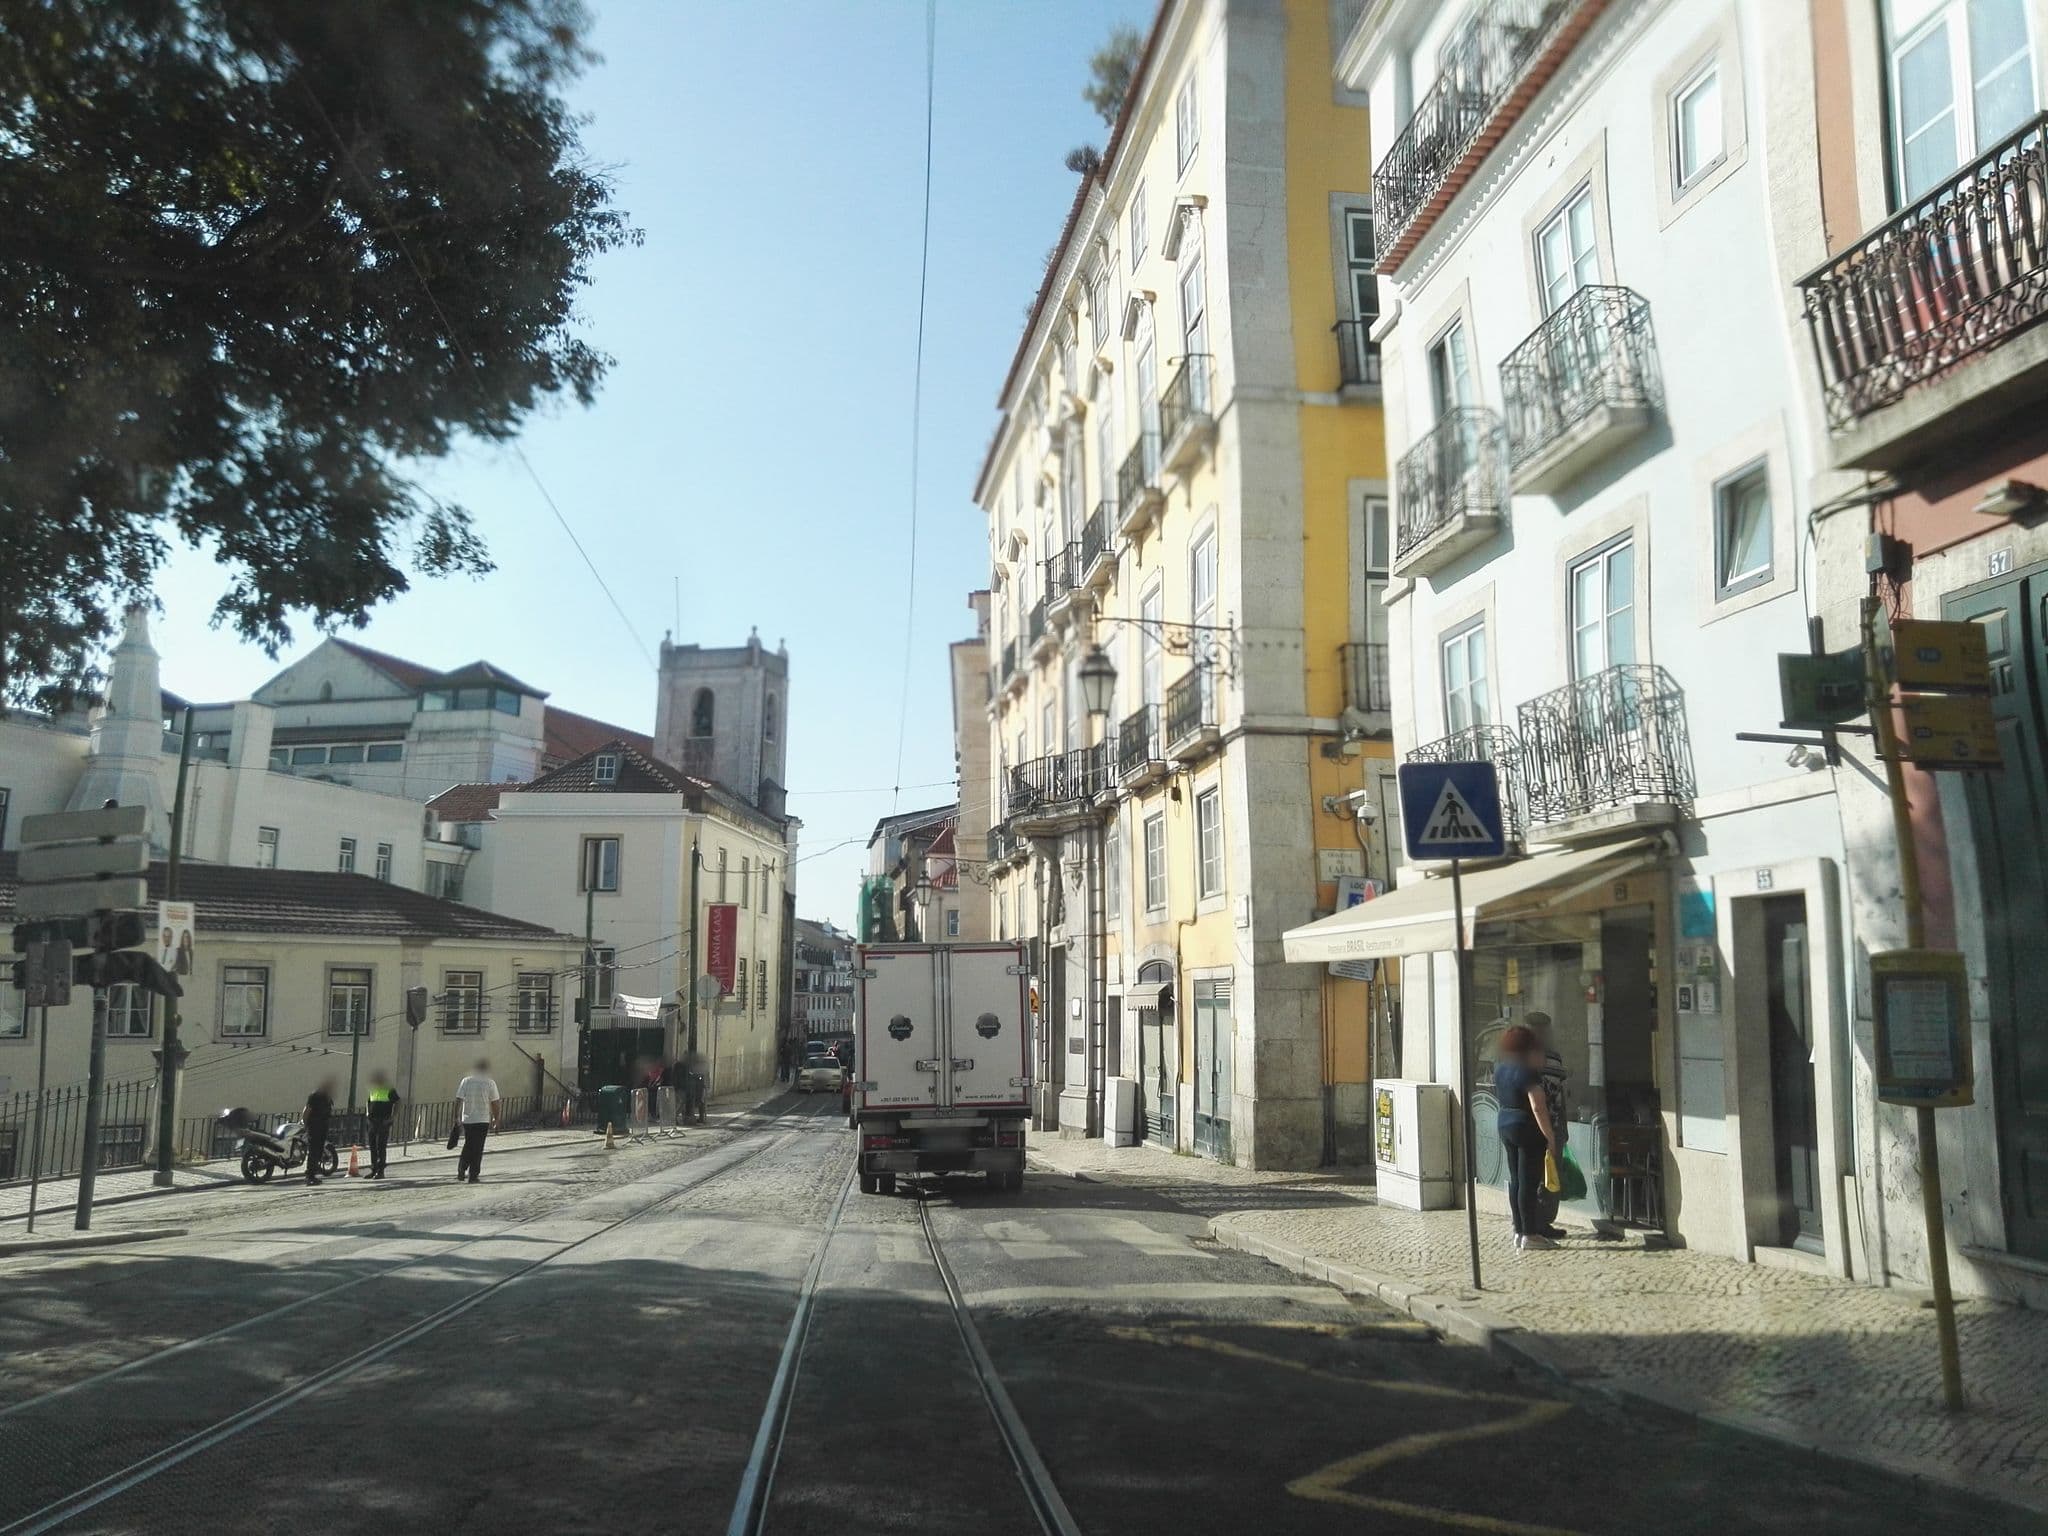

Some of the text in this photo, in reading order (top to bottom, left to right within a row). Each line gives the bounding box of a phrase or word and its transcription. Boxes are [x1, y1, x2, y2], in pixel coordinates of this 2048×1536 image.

[1990, 551, 2007, 575] 57
[711, 907, 722, 966] SANTA CASA
[1346, 940, 1365, 953] BRASIL
